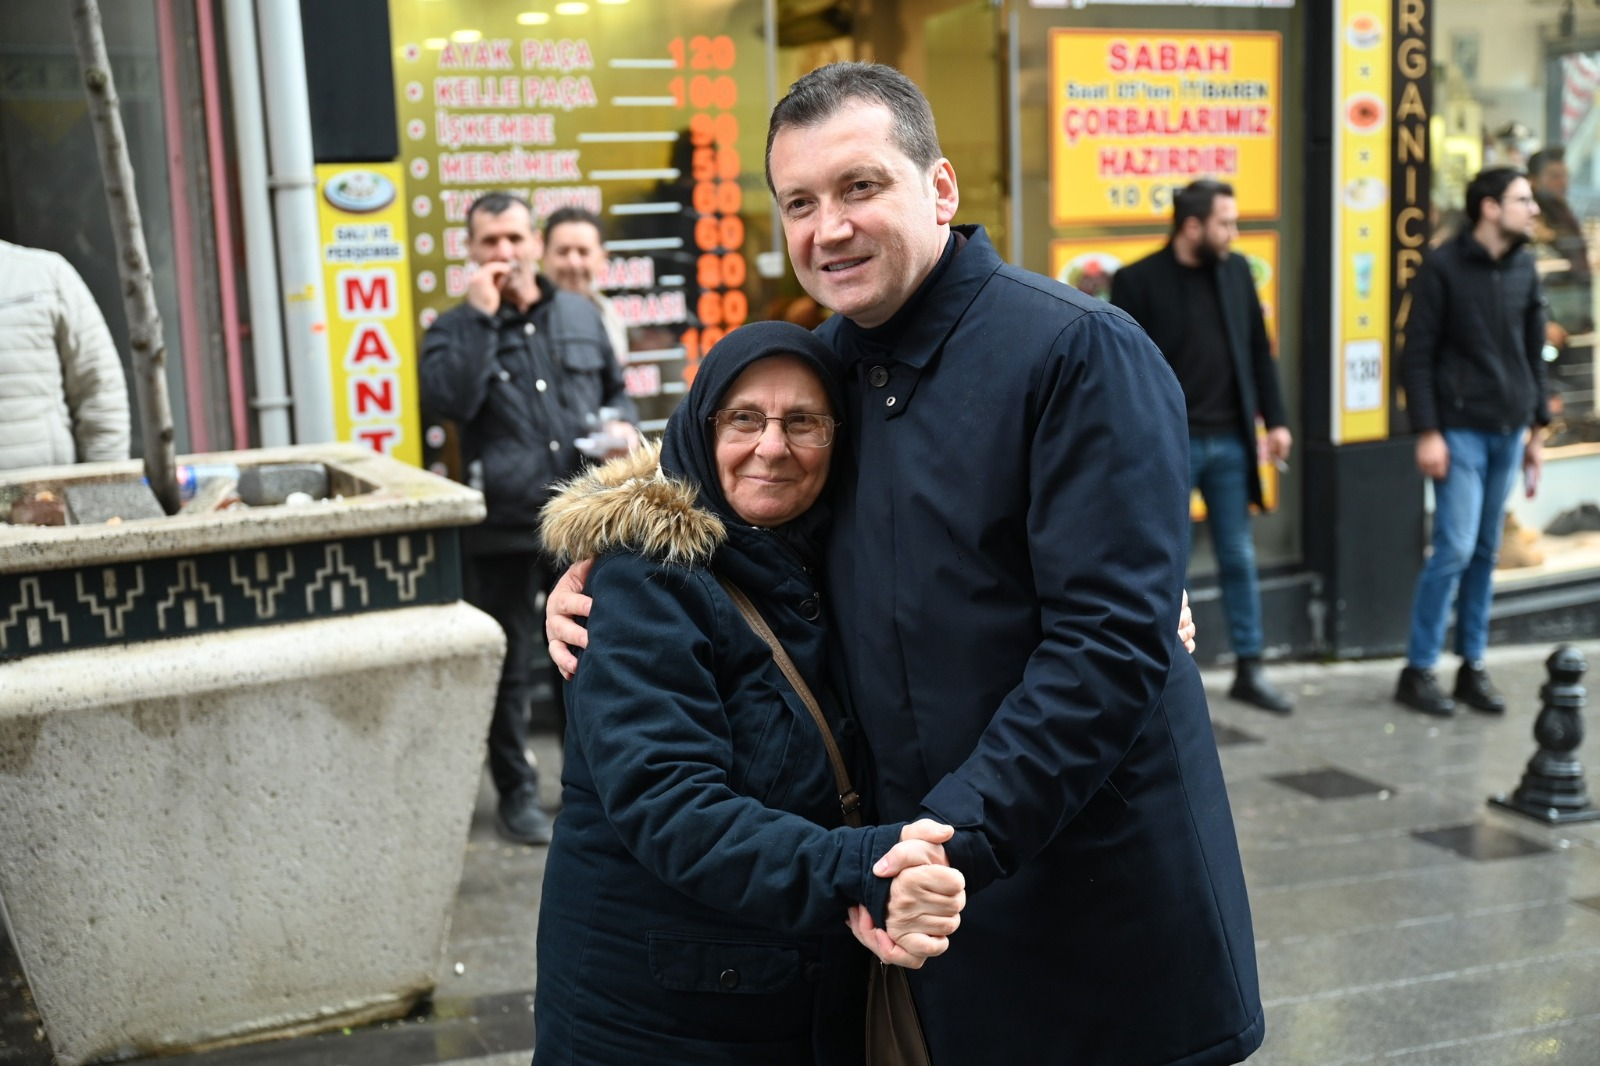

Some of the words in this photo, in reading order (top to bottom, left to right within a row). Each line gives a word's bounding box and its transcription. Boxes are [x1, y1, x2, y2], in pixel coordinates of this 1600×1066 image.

[439, 40, 513, 69] AYAK
[522, 39, 594, 73] PAÇA
[668, 36, 735, 69] 120
[1109, 42, 1230, 72] SABAH
[434, 77, 519, 107] KELLE
[524, 76, 597, 110] PAÇA
[669, 76, 737, 108] 100
[436, 109, 556, 148] İŞKEMBE
[1064, 106, 1272, 144] ÇORBALARIMIZ
[439, 147, 581, 183] MERCİMEK
